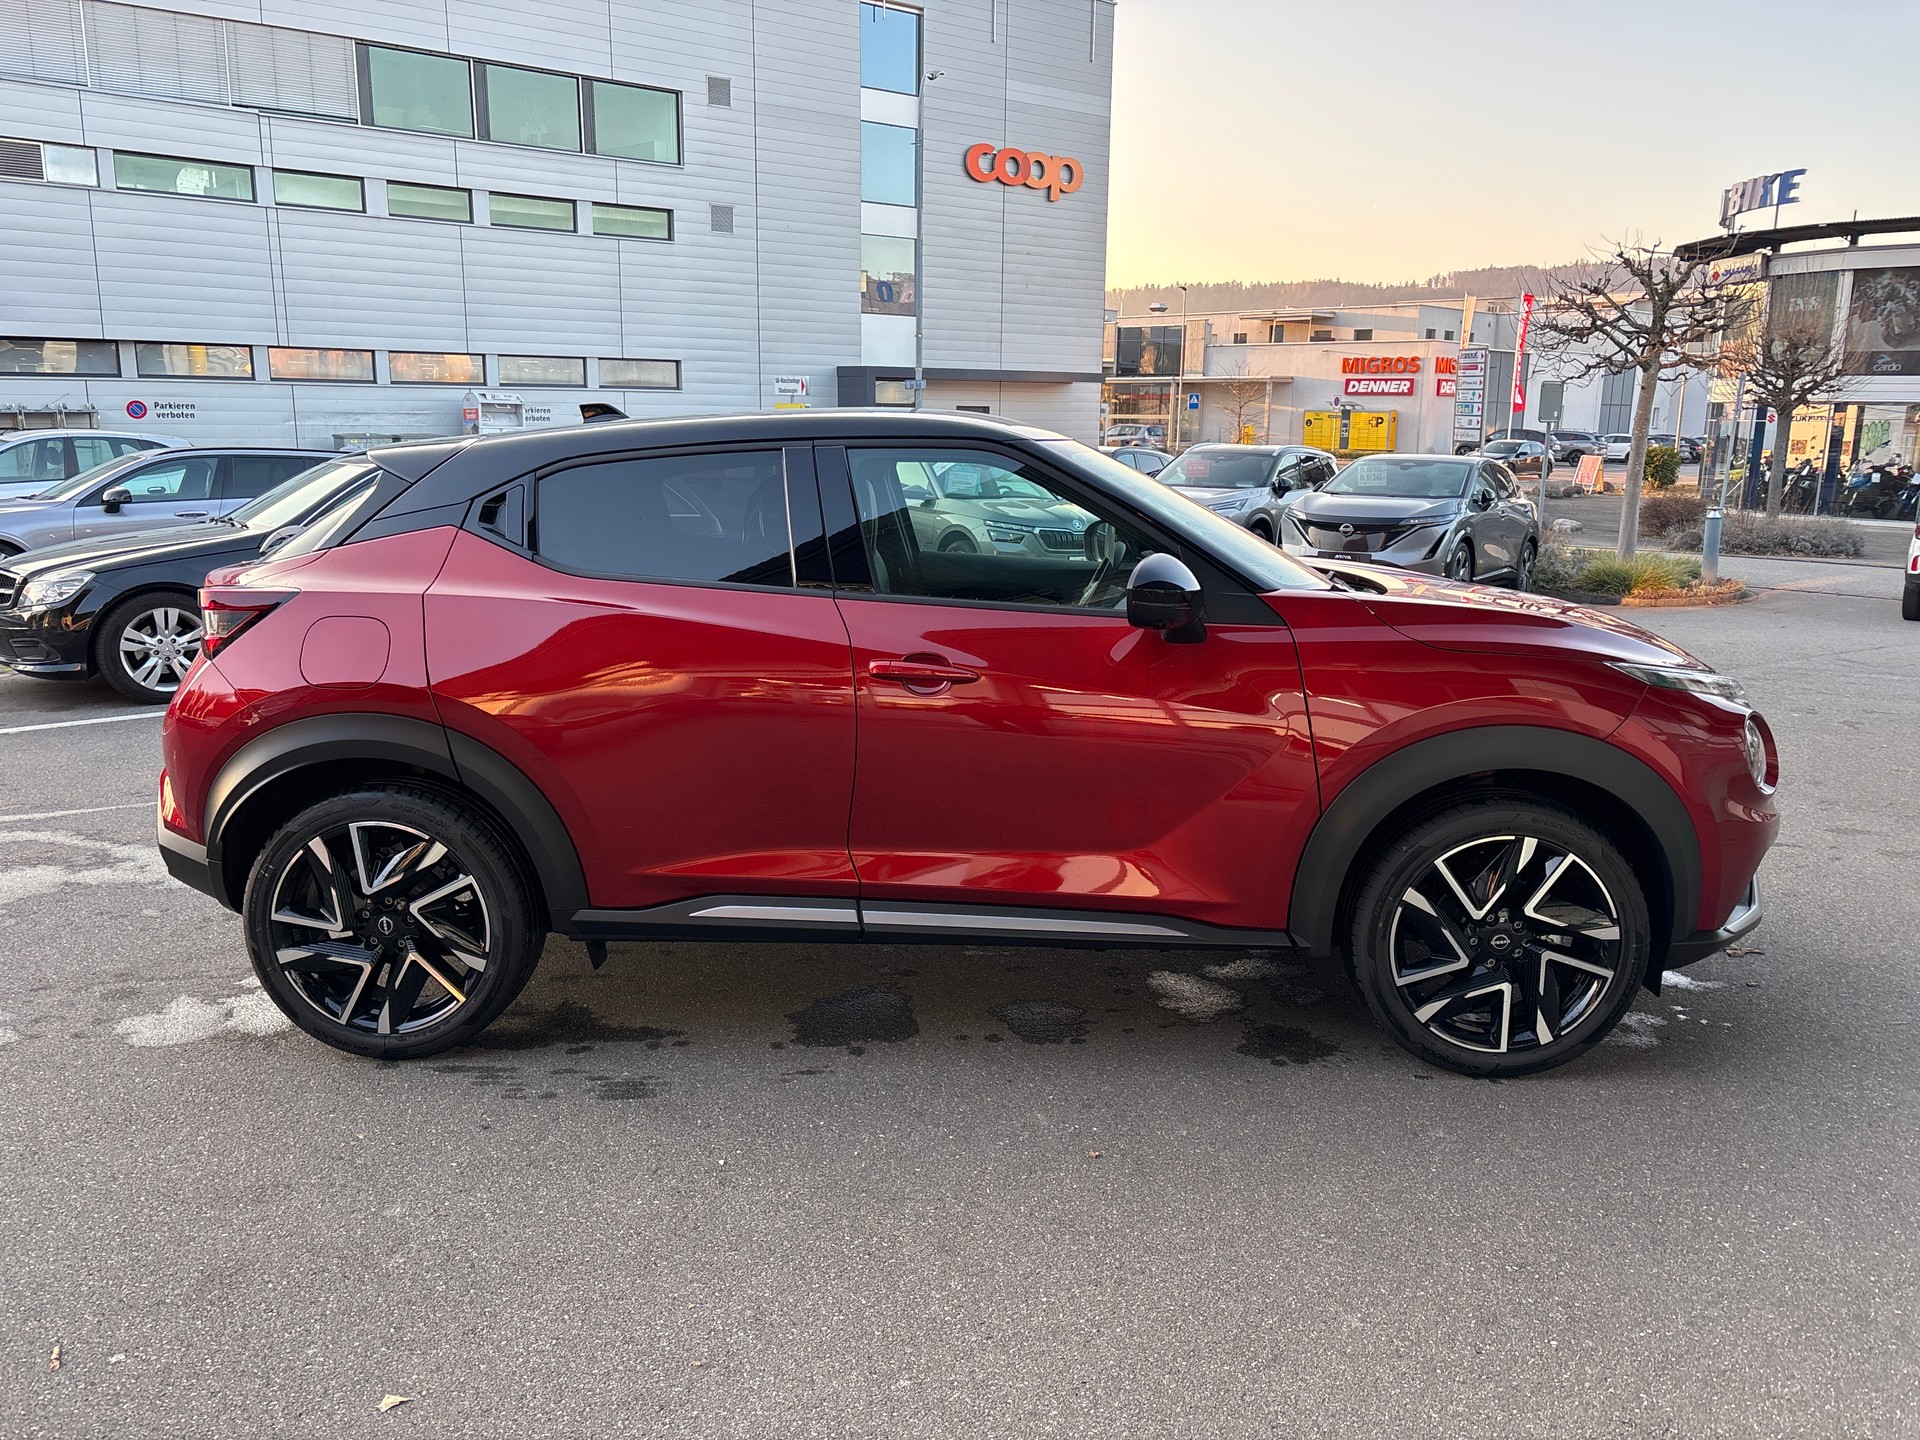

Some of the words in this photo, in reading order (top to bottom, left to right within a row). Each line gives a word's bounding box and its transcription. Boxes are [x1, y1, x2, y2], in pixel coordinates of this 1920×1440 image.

[965, 143, 1084, 202] coop
[1342, 356, 1420, 374] MIGROS
[1435, 356, 1457, 374] MIG
[1873, 362, 1902, 372] cardo
[1347, 380, 1411, 393] DENNER
[1440, 381, 1456, 393] DEN
[153, 401, 196, 411] Parkieren
[524, 406, 551, 414] arkieren
[156, 410, 196, 419] verboten
